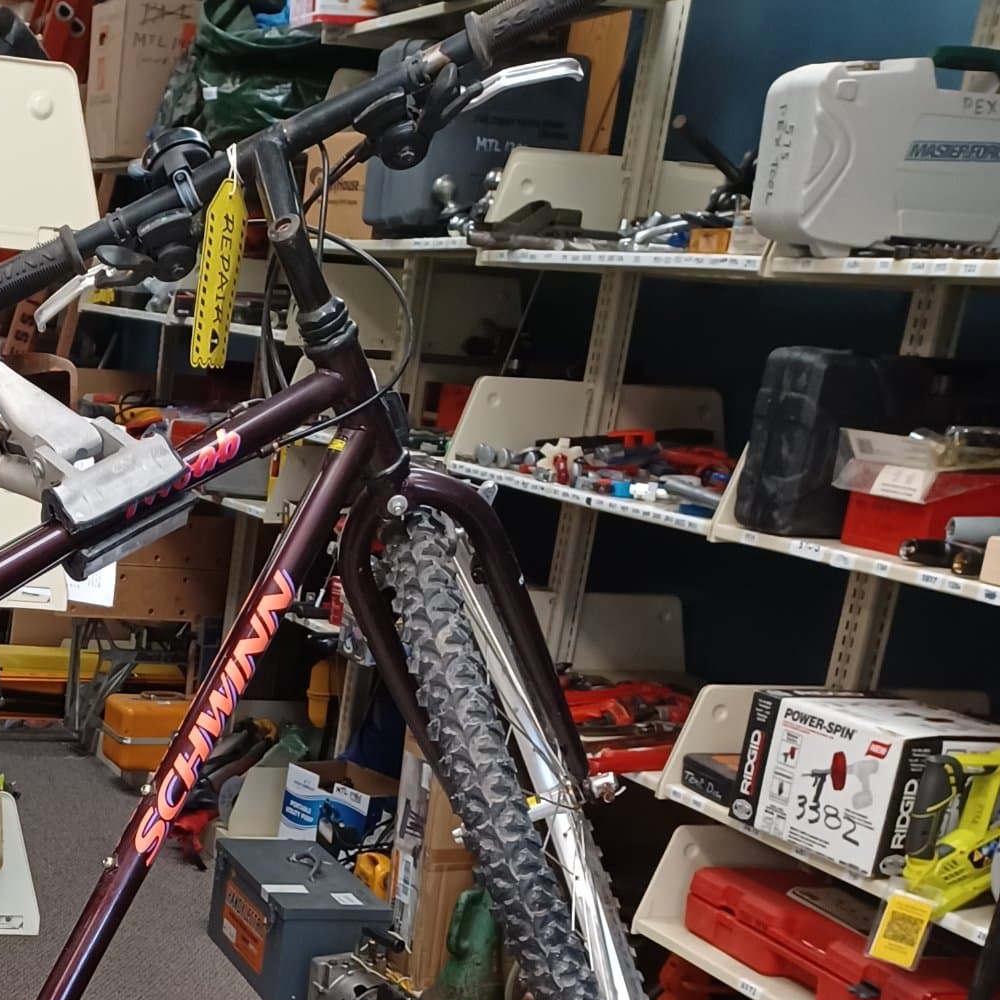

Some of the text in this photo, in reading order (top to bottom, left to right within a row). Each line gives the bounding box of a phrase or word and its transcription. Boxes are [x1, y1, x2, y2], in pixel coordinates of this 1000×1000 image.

[962, 96, 998, 115] PEX
[213, 212, 236, 324] REPAIR
[134, 568, 296, 867] SCHWINN
[740, 729, 765, 797] RIDGID
[795, 795, 860, 847] 3382
[890, 778, 919, 849] RIDGID
